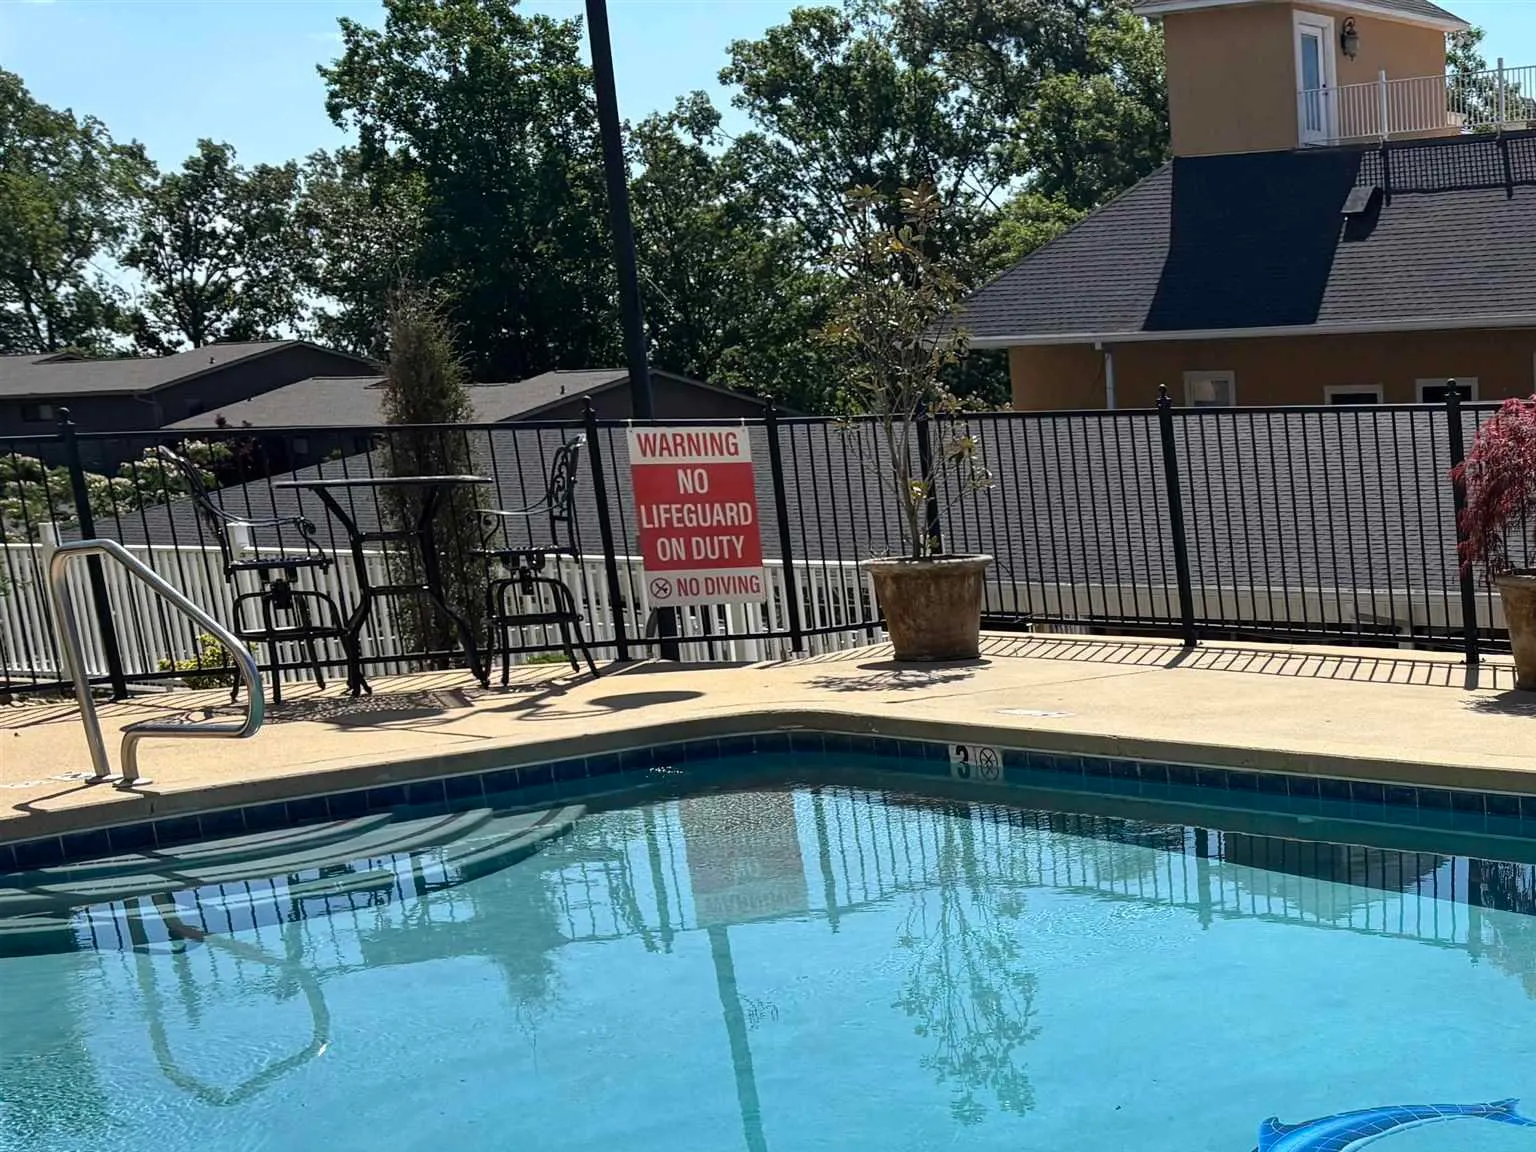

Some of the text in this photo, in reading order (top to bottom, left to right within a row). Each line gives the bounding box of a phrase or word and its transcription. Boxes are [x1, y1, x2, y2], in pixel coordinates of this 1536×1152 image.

[636, 432, 739, 457] WARNING
[677, 468, 709, 494] NO
[640, 502, 753, 529] LIFEGUARD
[656, 536, 744, 561] ON DUTY
[676, 575, 761, 597] NO DIVING
